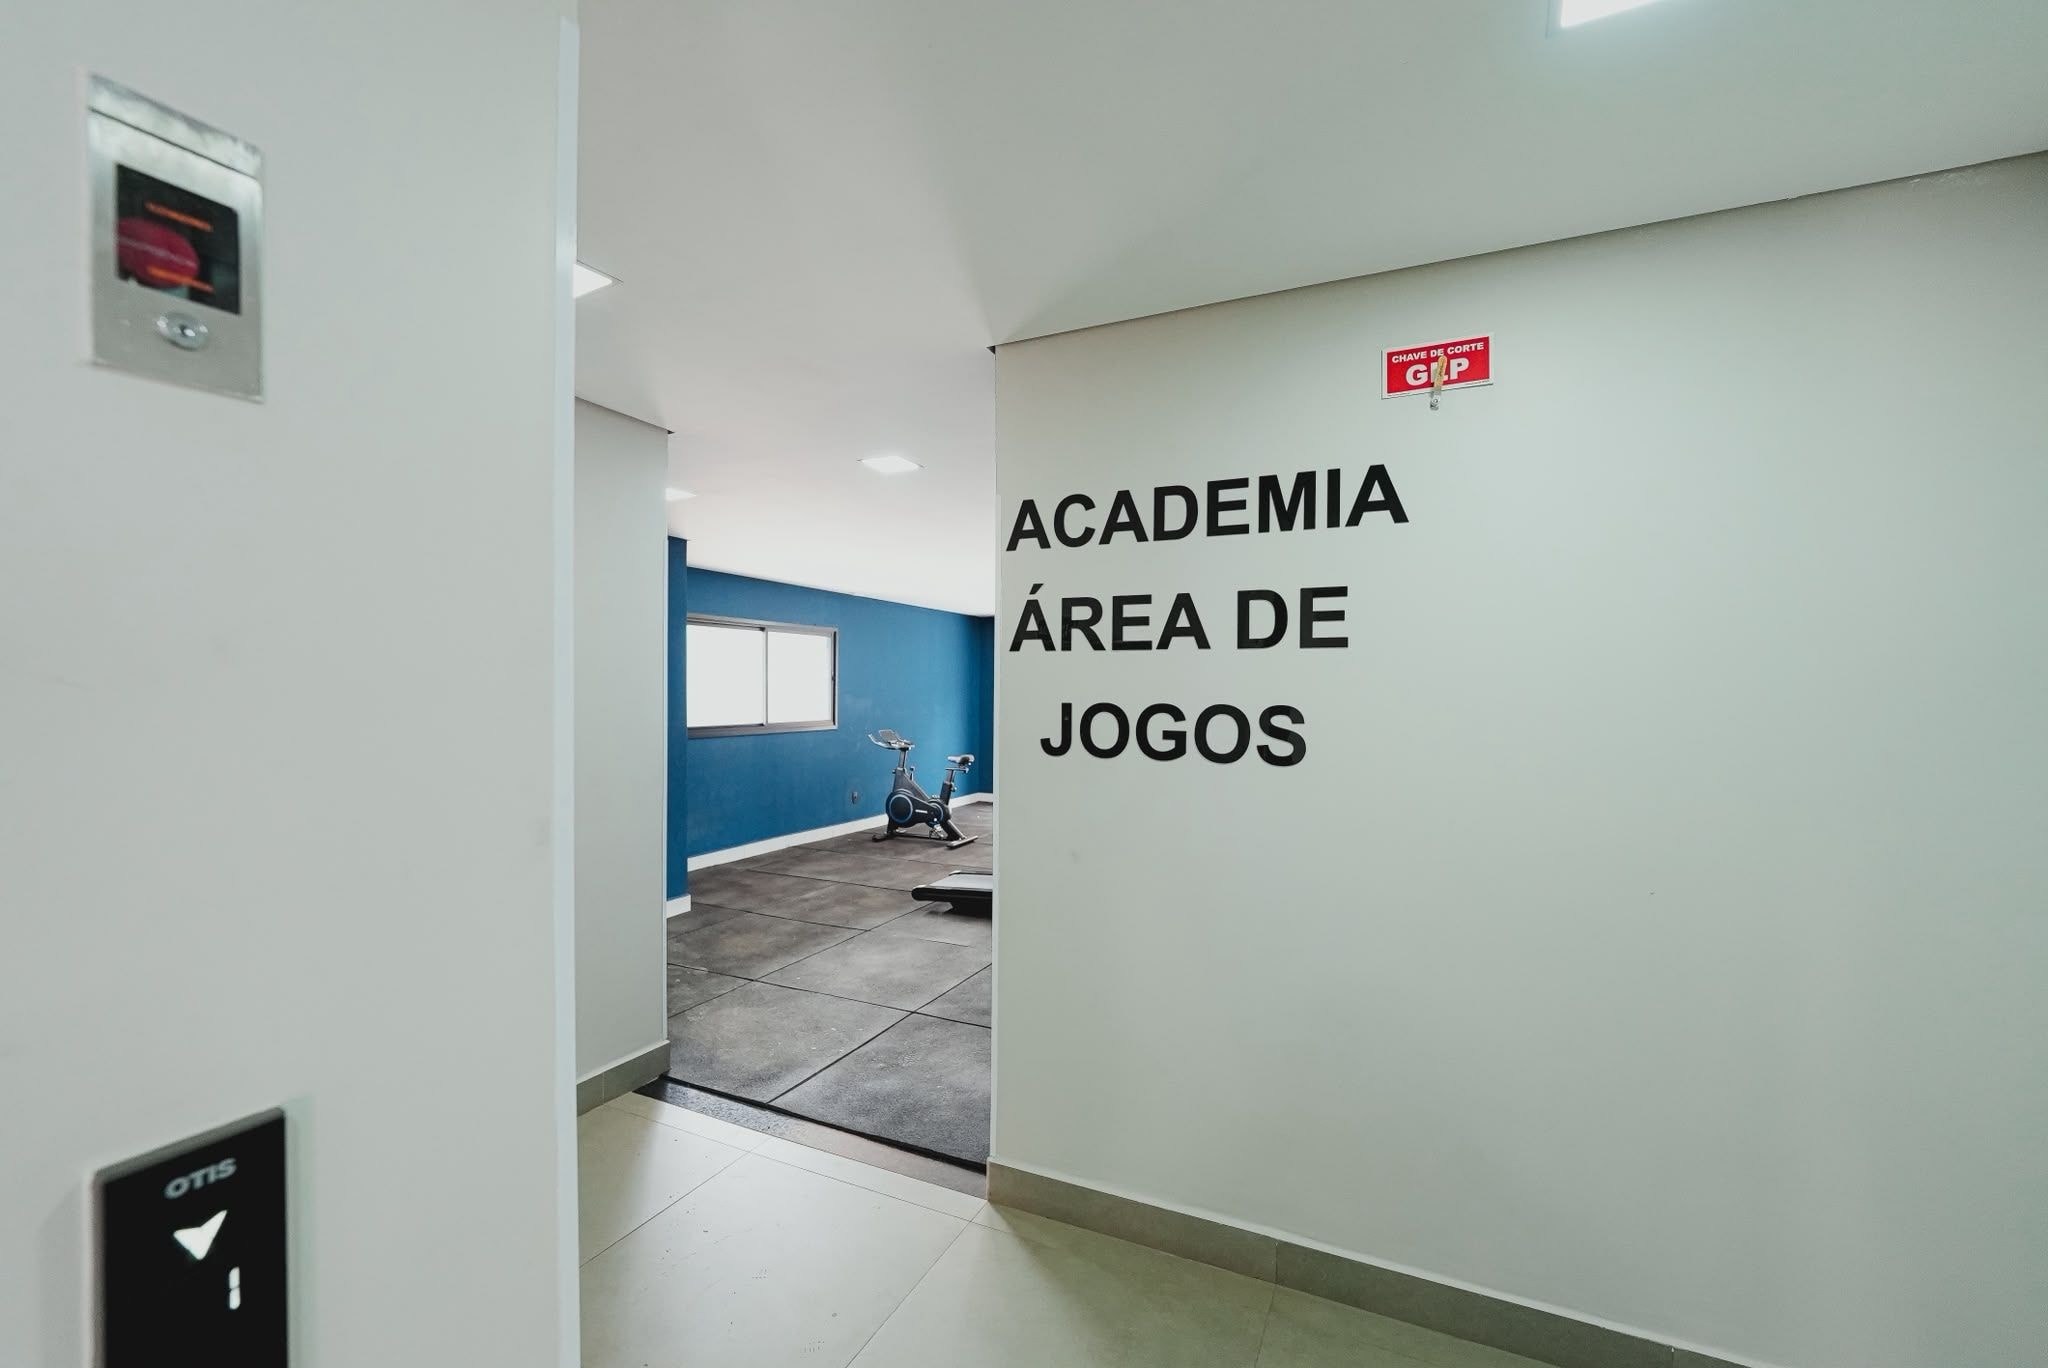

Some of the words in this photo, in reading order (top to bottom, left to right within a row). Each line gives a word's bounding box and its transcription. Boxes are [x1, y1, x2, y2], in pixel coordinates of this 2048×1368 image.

[1391, 350, 1427, 363] CHAVE
[1430, 348, 1444, 358] DE
[1447, 342, 1484, 355] CORTE
[1006, 464, 1409, 552] ACADEMIA
[1009, 583, 1211, 652] ÁREA
[1237, 586, 1349, 649] DE
[1040, 702, 1307, 767] JOGOS
[164, 1157, 237, 1199] OTIS
